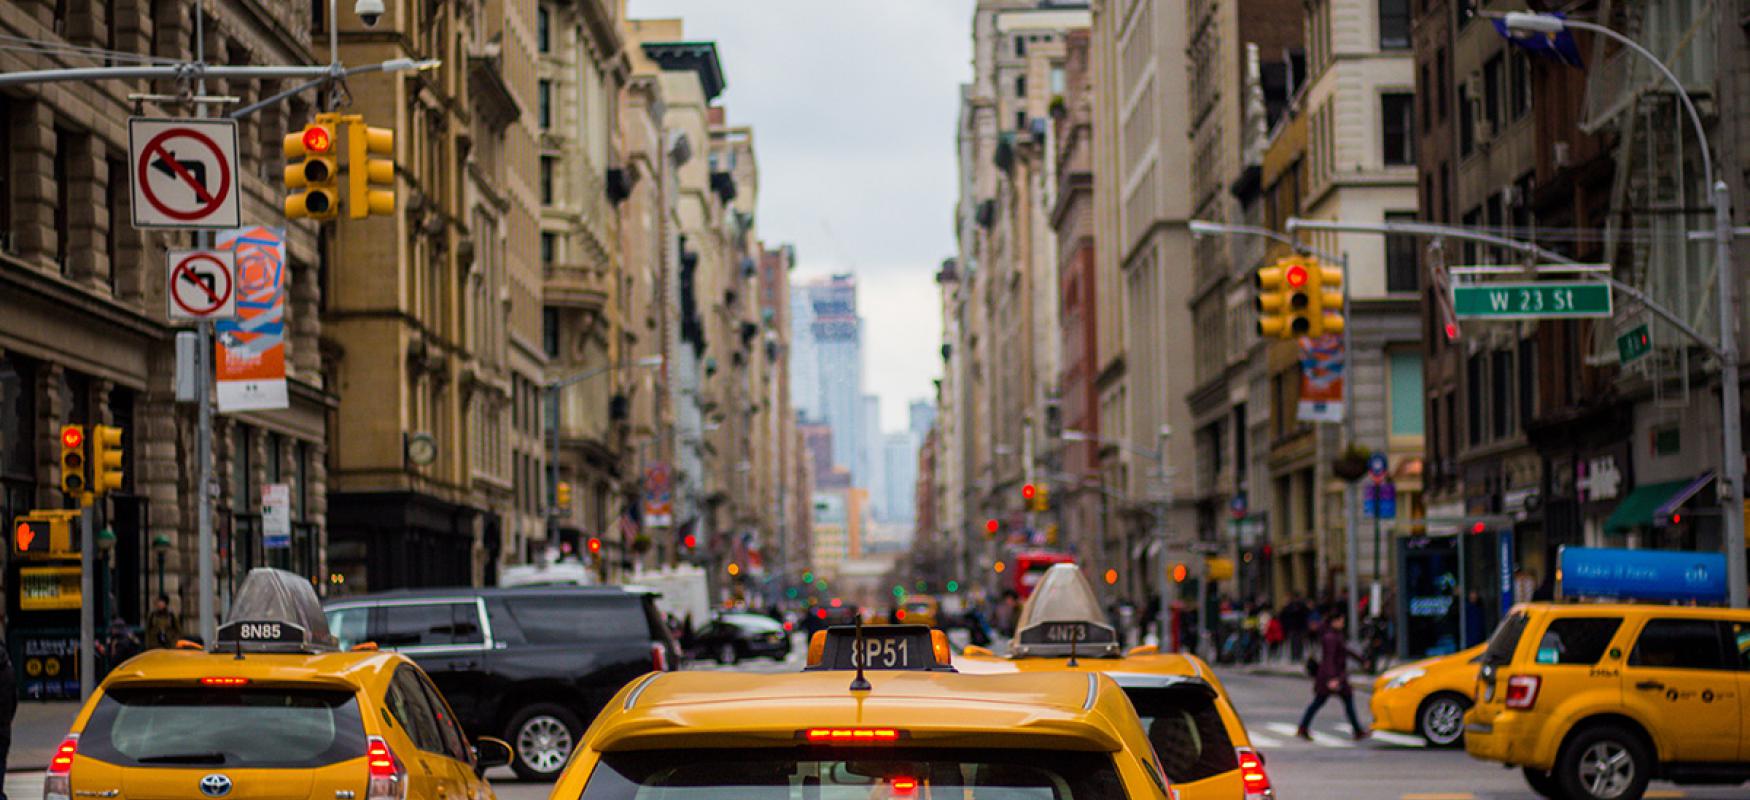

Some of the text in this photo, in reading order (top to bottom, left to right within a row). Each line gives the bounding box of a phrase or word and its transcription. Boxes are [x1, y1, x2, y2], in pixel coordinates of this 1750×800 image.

[1489, 289, 1574, 311] W 23 St
[1577, 564, 1610, 578] Make
[241, 624, 281, 639] 8N85
[1046, 624, 1086, 641] 4N73
[851, 638, 909, 668] 8P51
